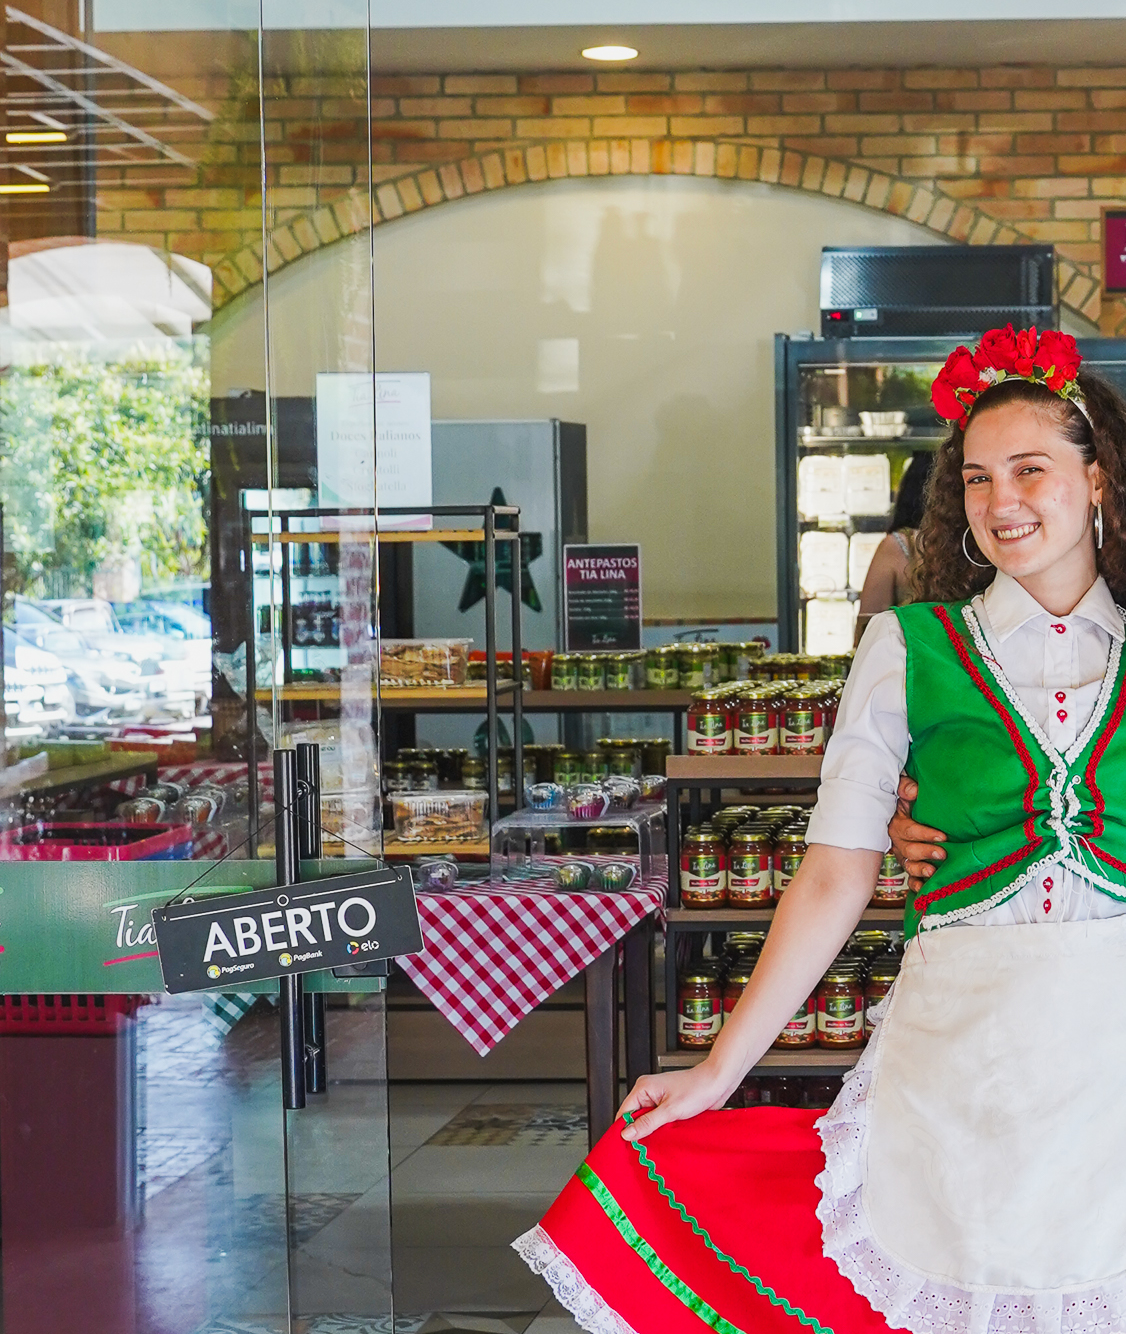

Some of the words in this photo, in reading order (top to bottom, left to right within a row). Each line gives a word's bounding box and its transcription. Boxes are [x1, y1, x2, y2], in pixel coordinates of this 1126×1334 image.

[331, 430, 366, 442] Doces
[370, 430, 421, 442] Ialianos
[567, 558, 638, 568] ANTEPASTOS
[579, 570, 598, 580] TIA
[600, 569, 626, 579] LINA
[110, 903, 158, 949] Tia
[203, 897, 376, 963] ABERTO
[360, 939, 380, 952] elo
[293, 950, 323, 962] PagBank
[221, 962, 255, 974] PagSeguro
